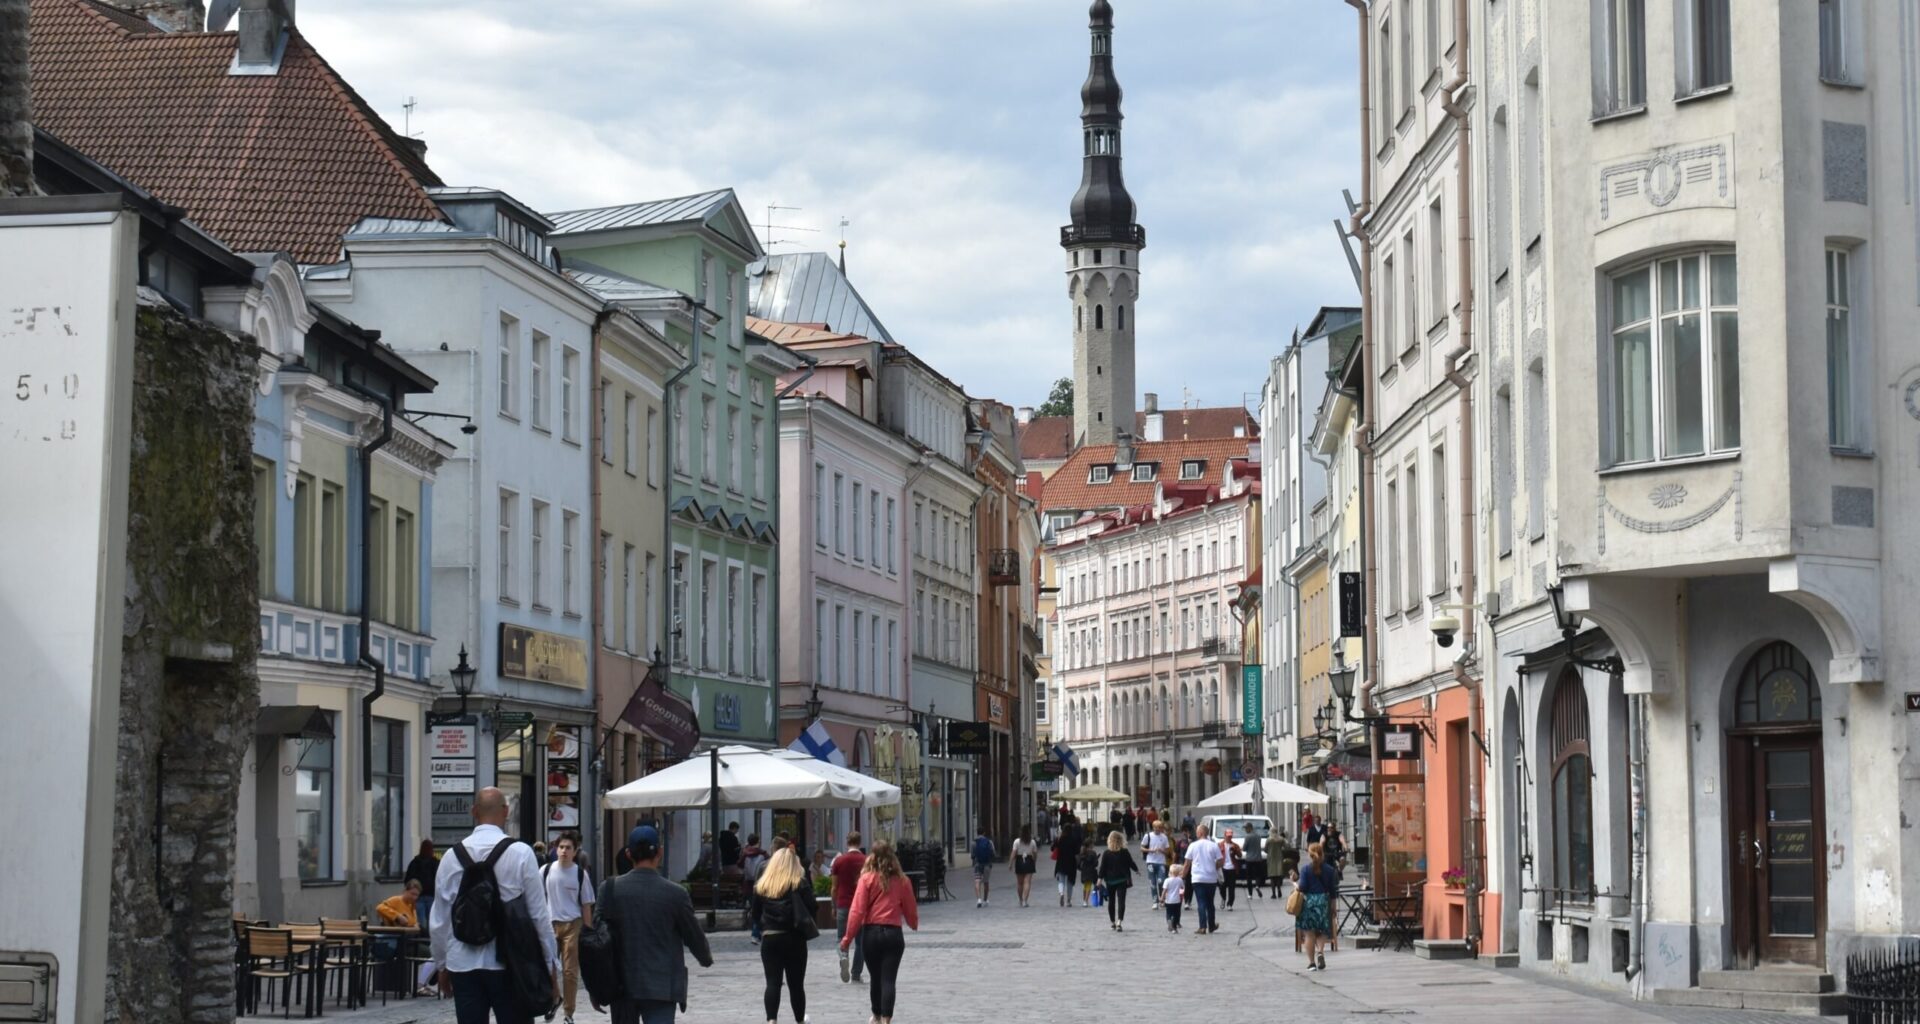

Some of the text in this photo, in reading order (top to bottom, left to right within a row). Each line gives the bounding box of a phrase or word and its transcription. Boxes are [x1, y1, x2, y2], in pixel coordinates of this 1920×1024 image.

[1248, 672, 1256, 728] SALAMANDER
[1912, 697, 1920, 706] V
[644, 698, 692, 733] GOODWIN
[435, 763, 452, 772] CAFE
